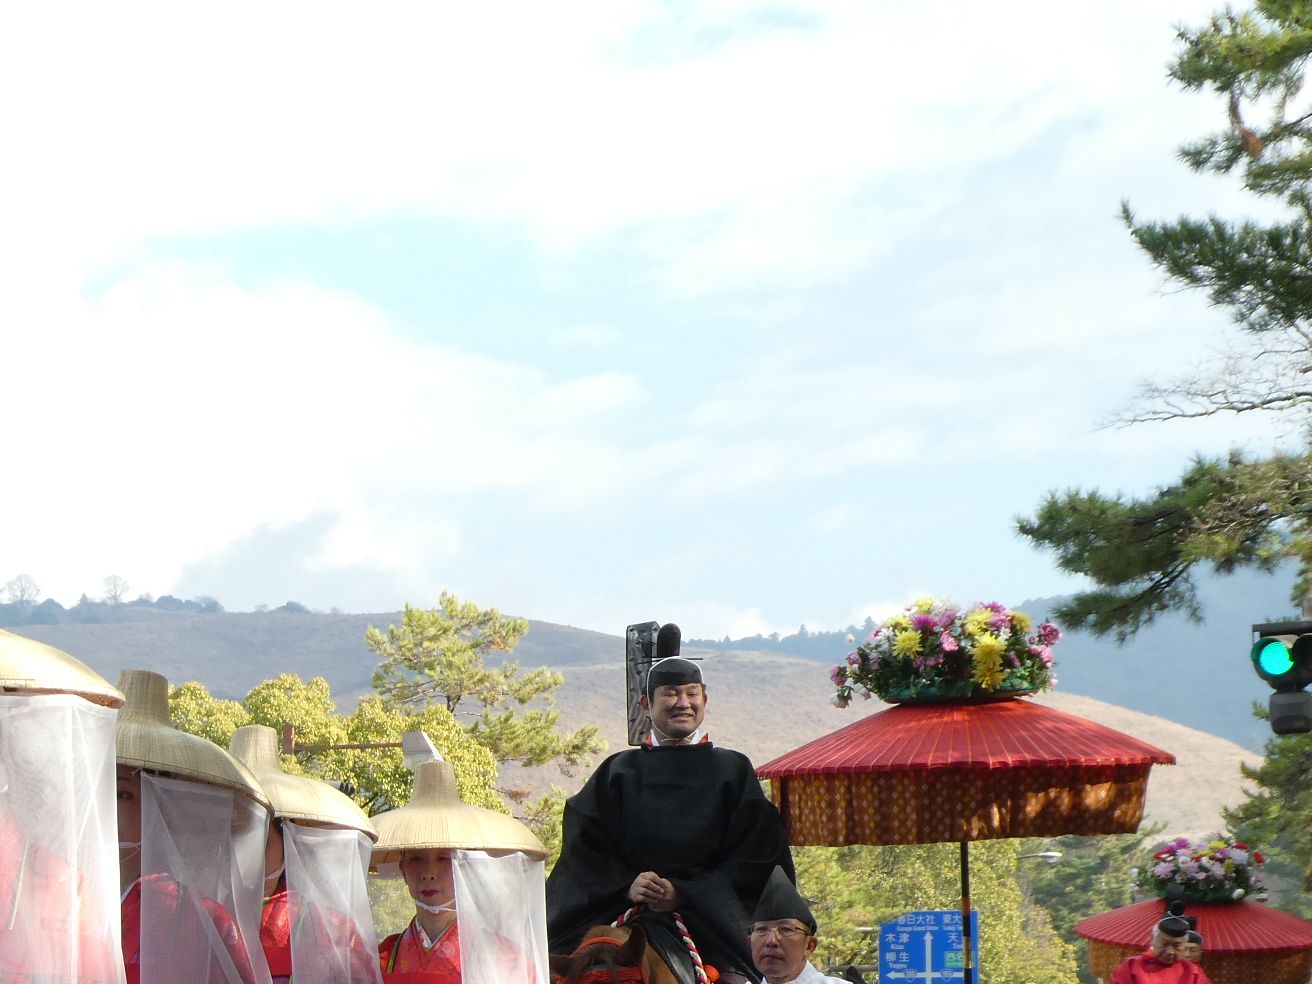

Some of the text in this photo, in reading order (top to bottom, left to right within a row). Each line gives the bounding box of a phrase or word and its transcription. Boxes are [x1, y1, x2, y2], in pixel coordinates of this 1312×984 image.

[897, 914, 935, 925] 春日大社
[942, 914, 962, 925] 東大
[948, 932, 959, 943] 天
